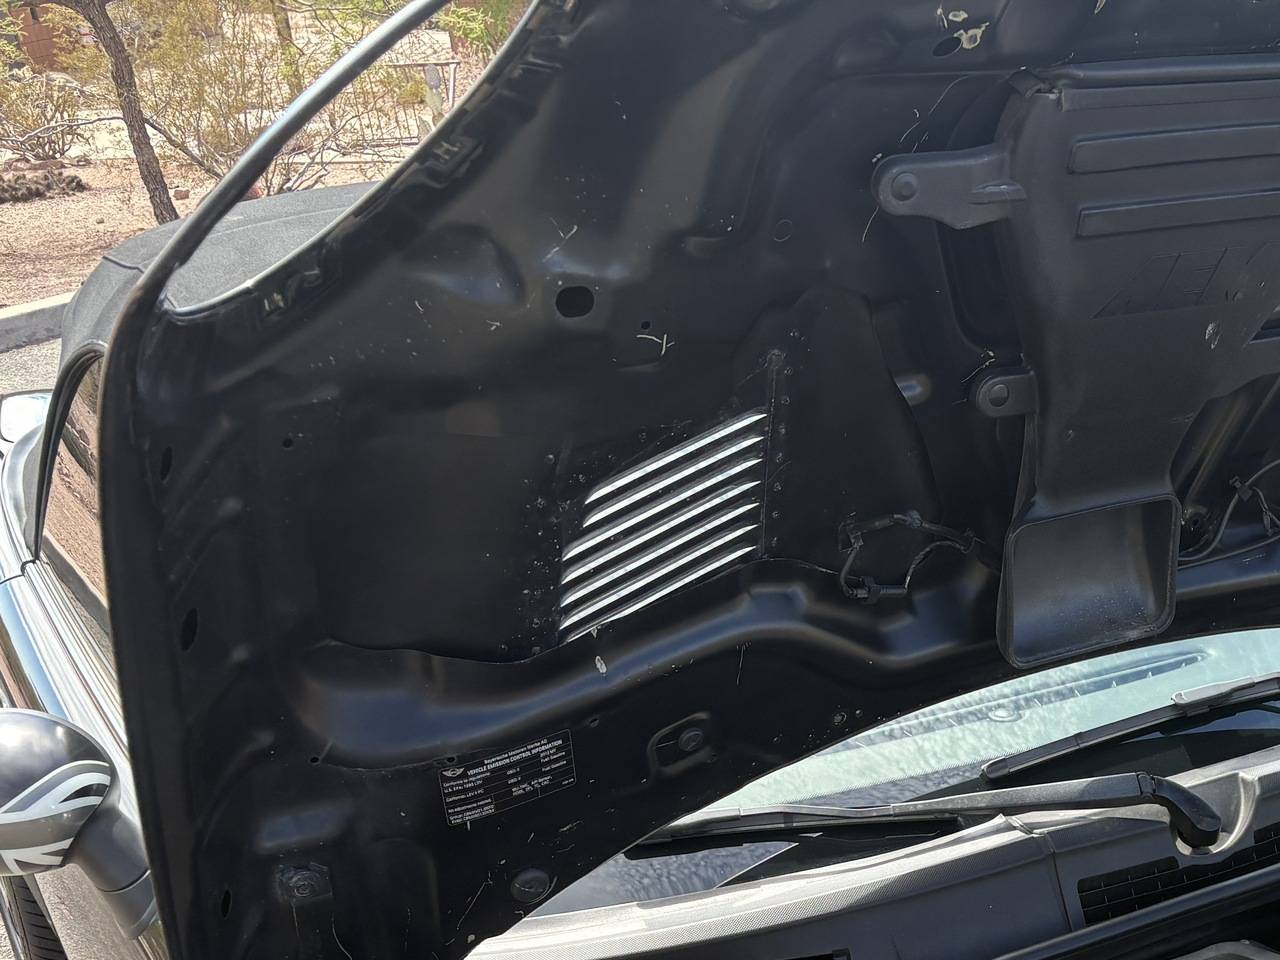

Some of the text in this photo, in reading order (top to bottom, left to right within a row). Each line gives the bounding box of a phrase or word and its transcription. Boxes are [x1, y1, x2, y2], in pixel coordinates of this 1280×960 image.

[468, 740, 562, 776] VEHICLE EMISSION CONTROL INFORMATION
